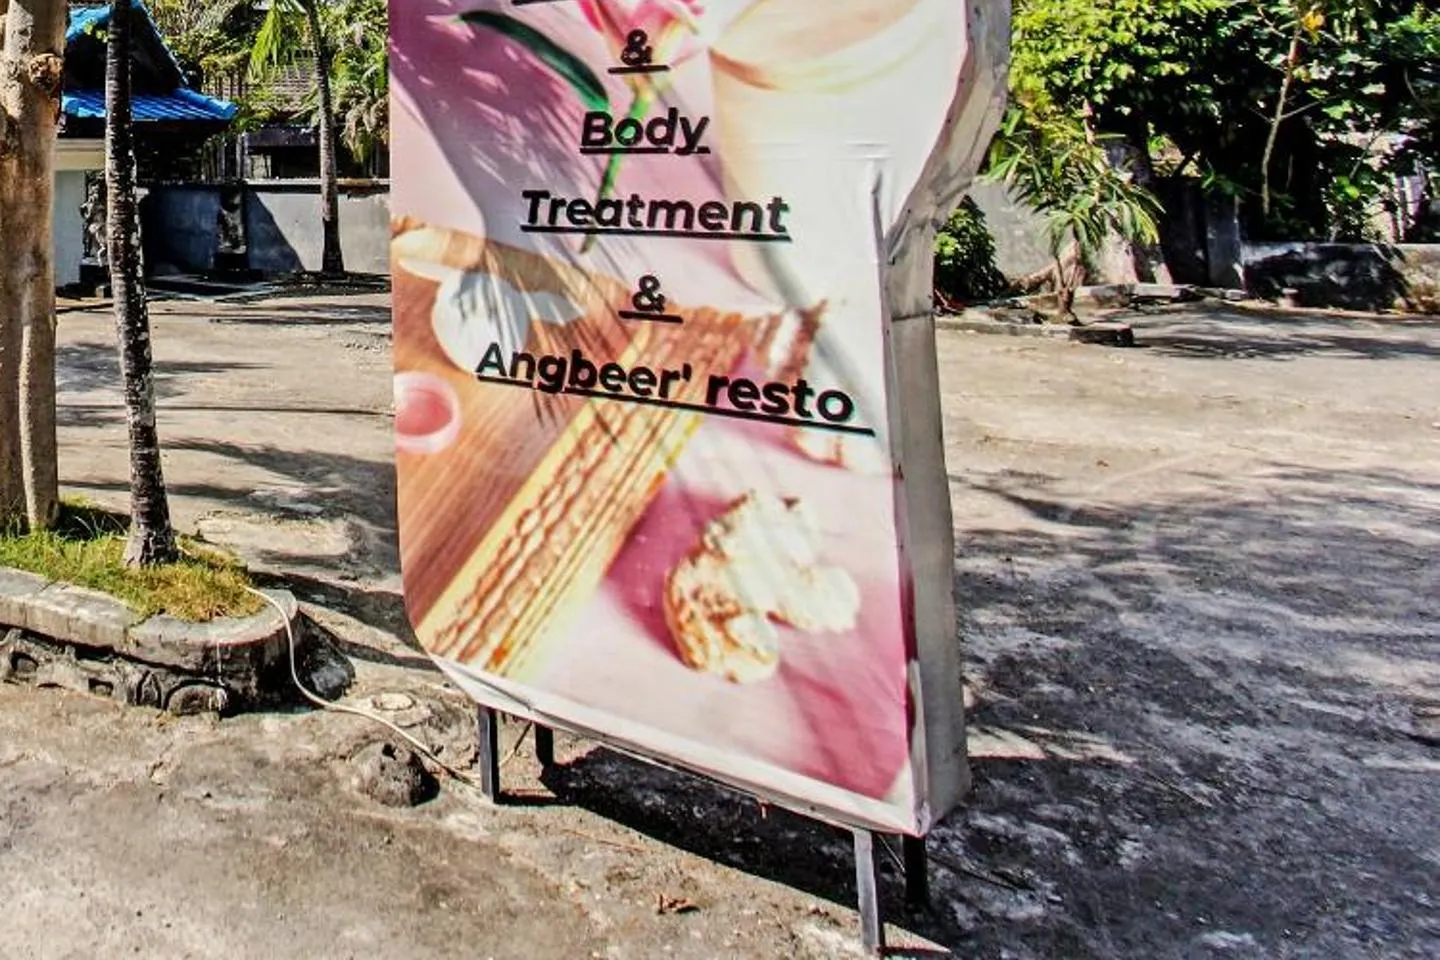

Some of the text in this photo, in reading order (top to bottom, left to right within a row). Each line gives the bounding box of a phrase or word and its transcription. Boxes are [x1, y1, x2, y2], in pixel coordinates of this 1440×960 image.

[620, 29, 653, 66] &
[582, 107, 710, 154] Body
[521, 190, 792, 234] Treatment
[632, 274, 665, 312] &
[476, 342, 853, 423] Angbeer' resto
